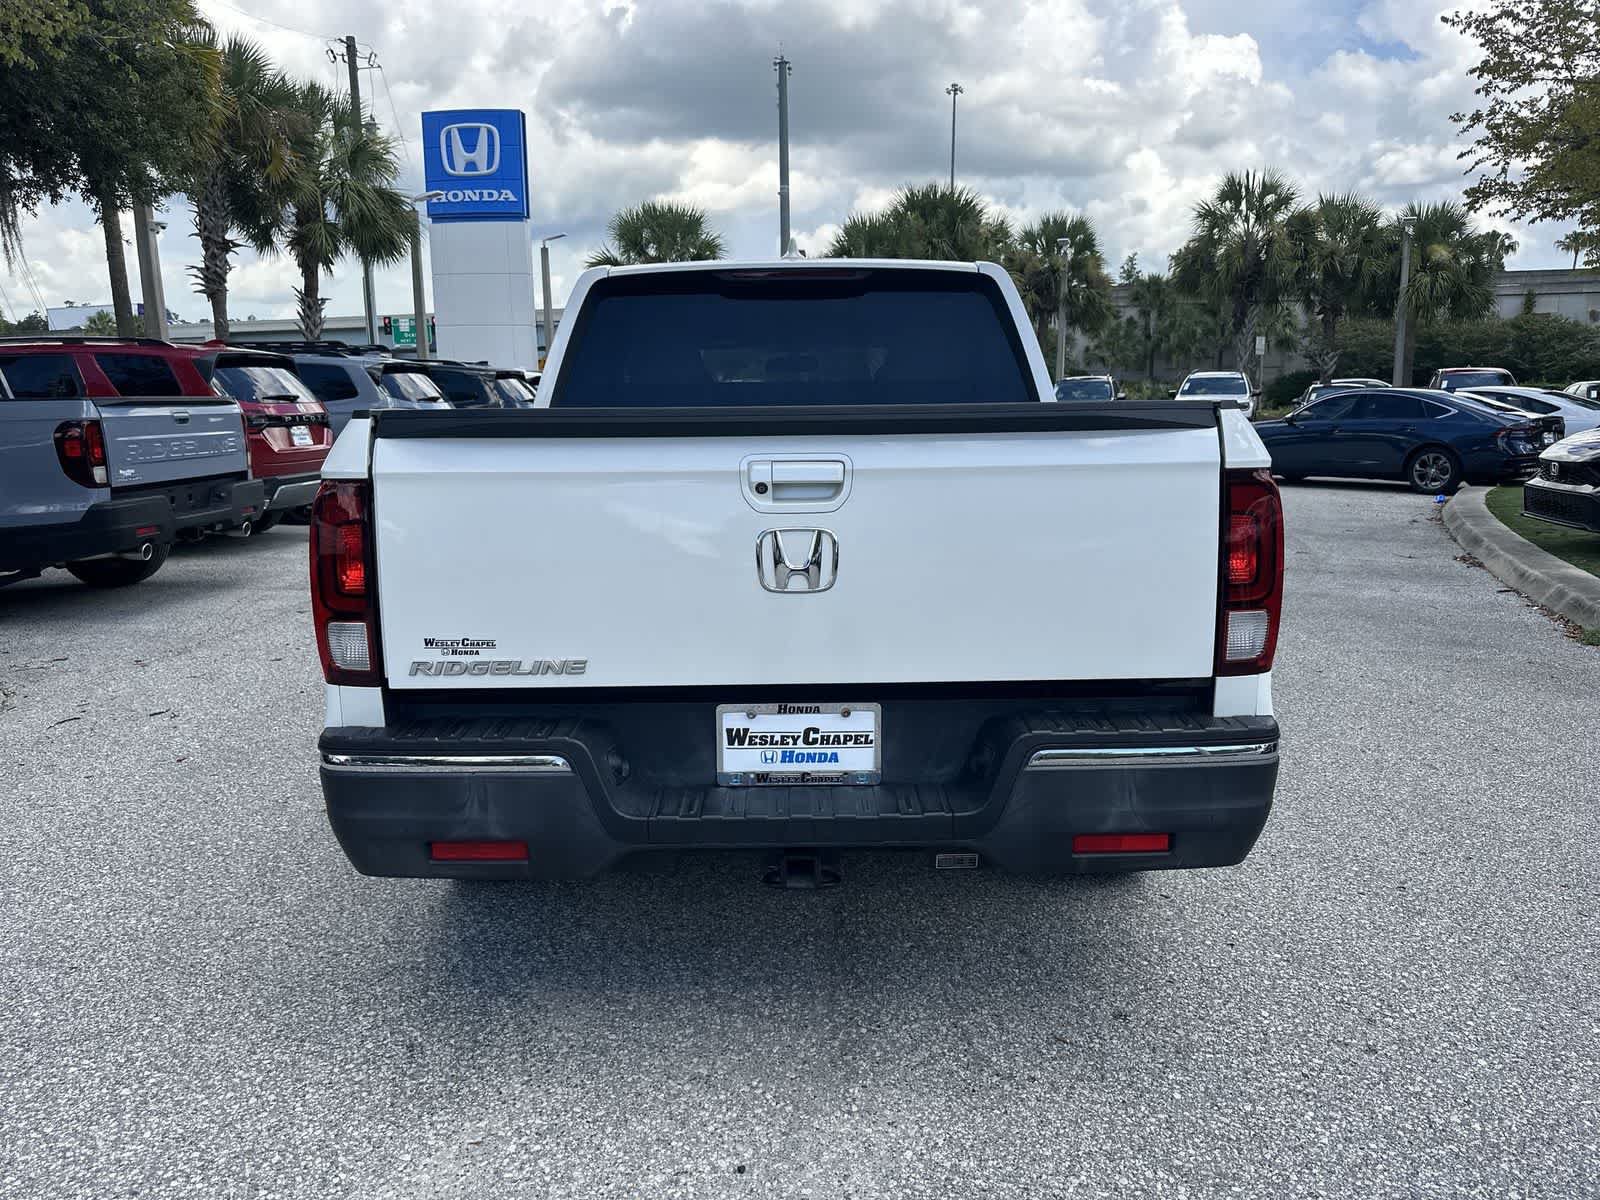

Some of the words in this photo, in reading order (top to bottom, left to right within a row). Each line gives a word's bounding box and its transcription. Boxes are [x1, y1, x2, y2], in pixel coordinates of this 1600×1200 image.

[408, 659, 588, 677] RIDGELINE
[777, 704, 821, 714] HONDA
[726, 727, 802, 747] WESLEY
[802, 727, 874, 746] CHAPEL
[780, 750, 839, 764] HONDA
